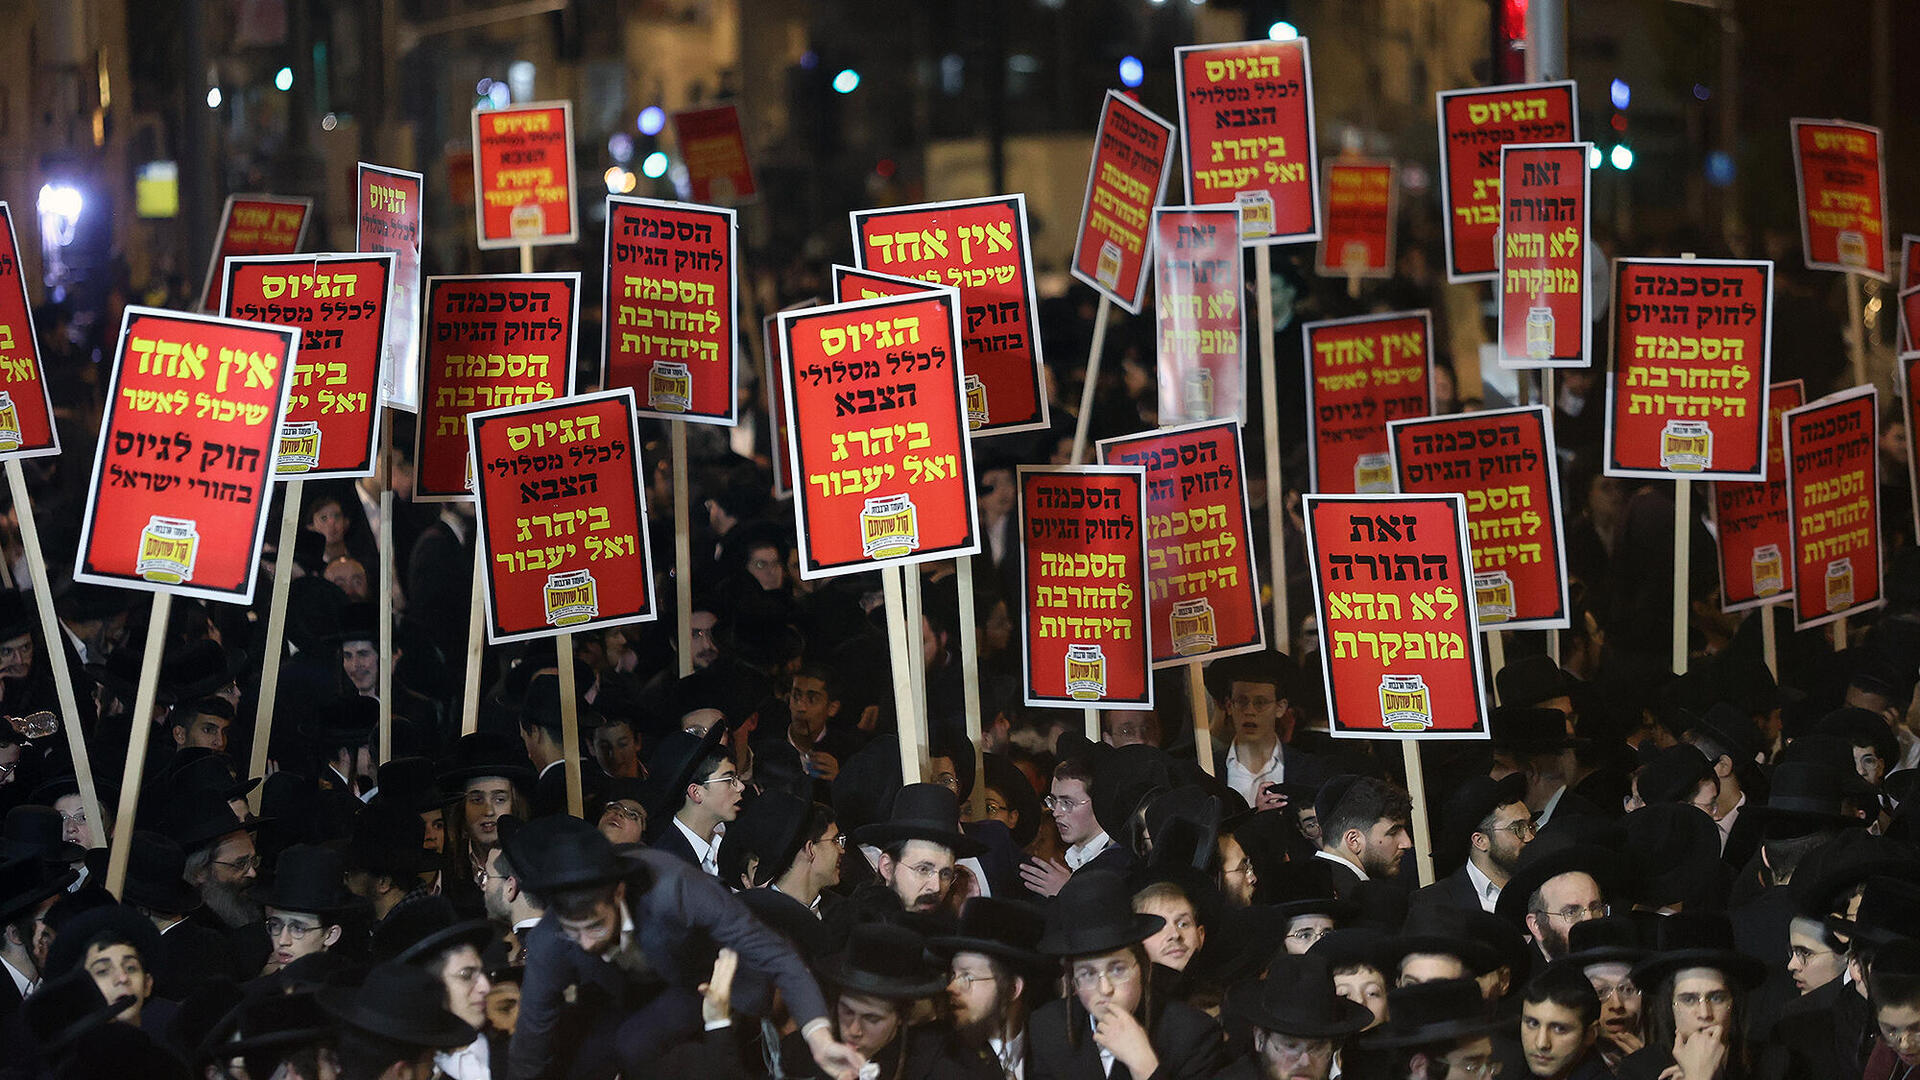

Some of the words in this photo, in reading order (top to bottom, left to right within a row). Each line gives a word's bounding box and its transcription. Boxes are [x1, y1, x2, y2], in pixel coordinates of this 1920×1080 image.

[1206, 56, 1280, 82] הגיוס
[1190, 86, 1250, 104] מסלולי
[1254, 80, 1299, 99] לכלל
[1215, 107, 1276, 128] הצבא
[1469, 99, 1547, 125] הגיוס
[1212, 137, 1285, 162] ביהרג
[1195, 167, 1258, 189] יעבור
[1265, 161, 1304, 184] ואל
[1522, 161, 1560, 187] זאת
[370, 184, 406, 215] הגיוס
[1509, 197, 1574, 223] התורה
[1456, 203, 1500, 225] בור
[623, 216, 711, 244] הסכמה
[955, 221, 1015, 265] אין
[1177, 224, 1216, 249] זאת
[1551, 227, 1577, 258] לא
[614, 242, 668, 267] הגיוס
[870, 227, 950, 265] אחד
[1506, 232, 1545, 258] תהא
[675, 249, 724, 273] לחוק
[262, 273, 359, 300] הגיוס
[624, 274, 715, 306] הסכמה
[945, 265, 1019, 289] שיכול
[1507, 267, 1577, 300] מופקרת
[1634, 275, 1743, 297] הסכמה
[237, 303, 314, 322] מסלולי
[319, 300, 377, 321] לכלל
[446, 292, 550, 313] הסכמה
[1208, 289, 1236, 320] לא
[1623, 302, 1689, 324] הגיוס
[1697, 301, 1757, 329] לחוק
[504, 316, 562, 346] לחוק
[618, 305, 722, 334] להחרבת
[964, 302, 1021, 334] חוק
[299, 329, 344, 351] הצ
[435, 321, 498, 343] הגיוס
[819, 316, 920, 356] הגיוס
[131, 336, 209, 380] אחד
[620, 332, 719, 362] היהדות
[886, 346, 946, 375] לכלל
[1635, 335, 1744, 361] הסכמה
[0, 354, 36, 383] ואל
[215, 346, 278, 393] אין
[292, 362, 349, 388] ביה
[444, 353, 549, 378] הסכמה
[799, 360, 880, 386] מסלולי
[1626, 364, 1750, 390] להחרבת
[122, 387, 189, 415] לאשר
[317, 389, 368, 415] ואל
[434, 380, 554, 407] להחרבת
[834, 383, 917, 417] הצבא
[1628, 393, 1746, 417] היהדות
[195, 392, 269, 425] שיכול
[115, 430, 192, 463] לגיוס
[506, 415, 601, 452] הגיוס
[831, 421, 931, 461] ביהרג
[1412, 426, 1521, 456] הסכמה
[199, 441, 260, 473] חוק
[487, 453, 563, 477] מסלולי
[568, 440, 626, 467] לכלל
[1478, 448, 1539, 482] לחוק
[109, 463, 181, 492] ישראל
[809, 463, 895, 497] יעבור
[902, 453, 957, 484] ואל
[1406, 460, 1472, 484] הגיוס
[188, 478, 252, 504] בחורי
[520, 473, 598, 504] הצבא
[1181, 464, 1234, 501] לחוק
[1035, 486, 1121, 509] הסכמה
[1466, 485, 1532, 513] הסכ
[516, 506, 611, 542] ביהרג
[896, 515, 908, 534] קול
[1029, 517, 1081, 540] הגיוס
[1086, 513, 1134, 545] לחוק
[1349, 514, 1417, 542] זאת
[1468, 511, 1542, 541] להחר
[496, 543, 577, 574] יעבור
[584, 534, 636, 561] ואל
[1148, 531, 1236, 571] להחרב
[1472, 544, 1541, 569] היהד
[1039, 552, 1126, 579] הסכמה
[1328, 553, 1448, 581] התורה
[578, 587, 589, 604] קול
[1034, 582, 1132, 610] להחרבת
[1328, 591, 1402, 620] תהא
[1409, 586, 1458, 620] לא
[1038, 615, 1131, 640] היהדות
[1334, 630, 1464, 666] מופקרת
[1411, 693, 1423, 711] קול
